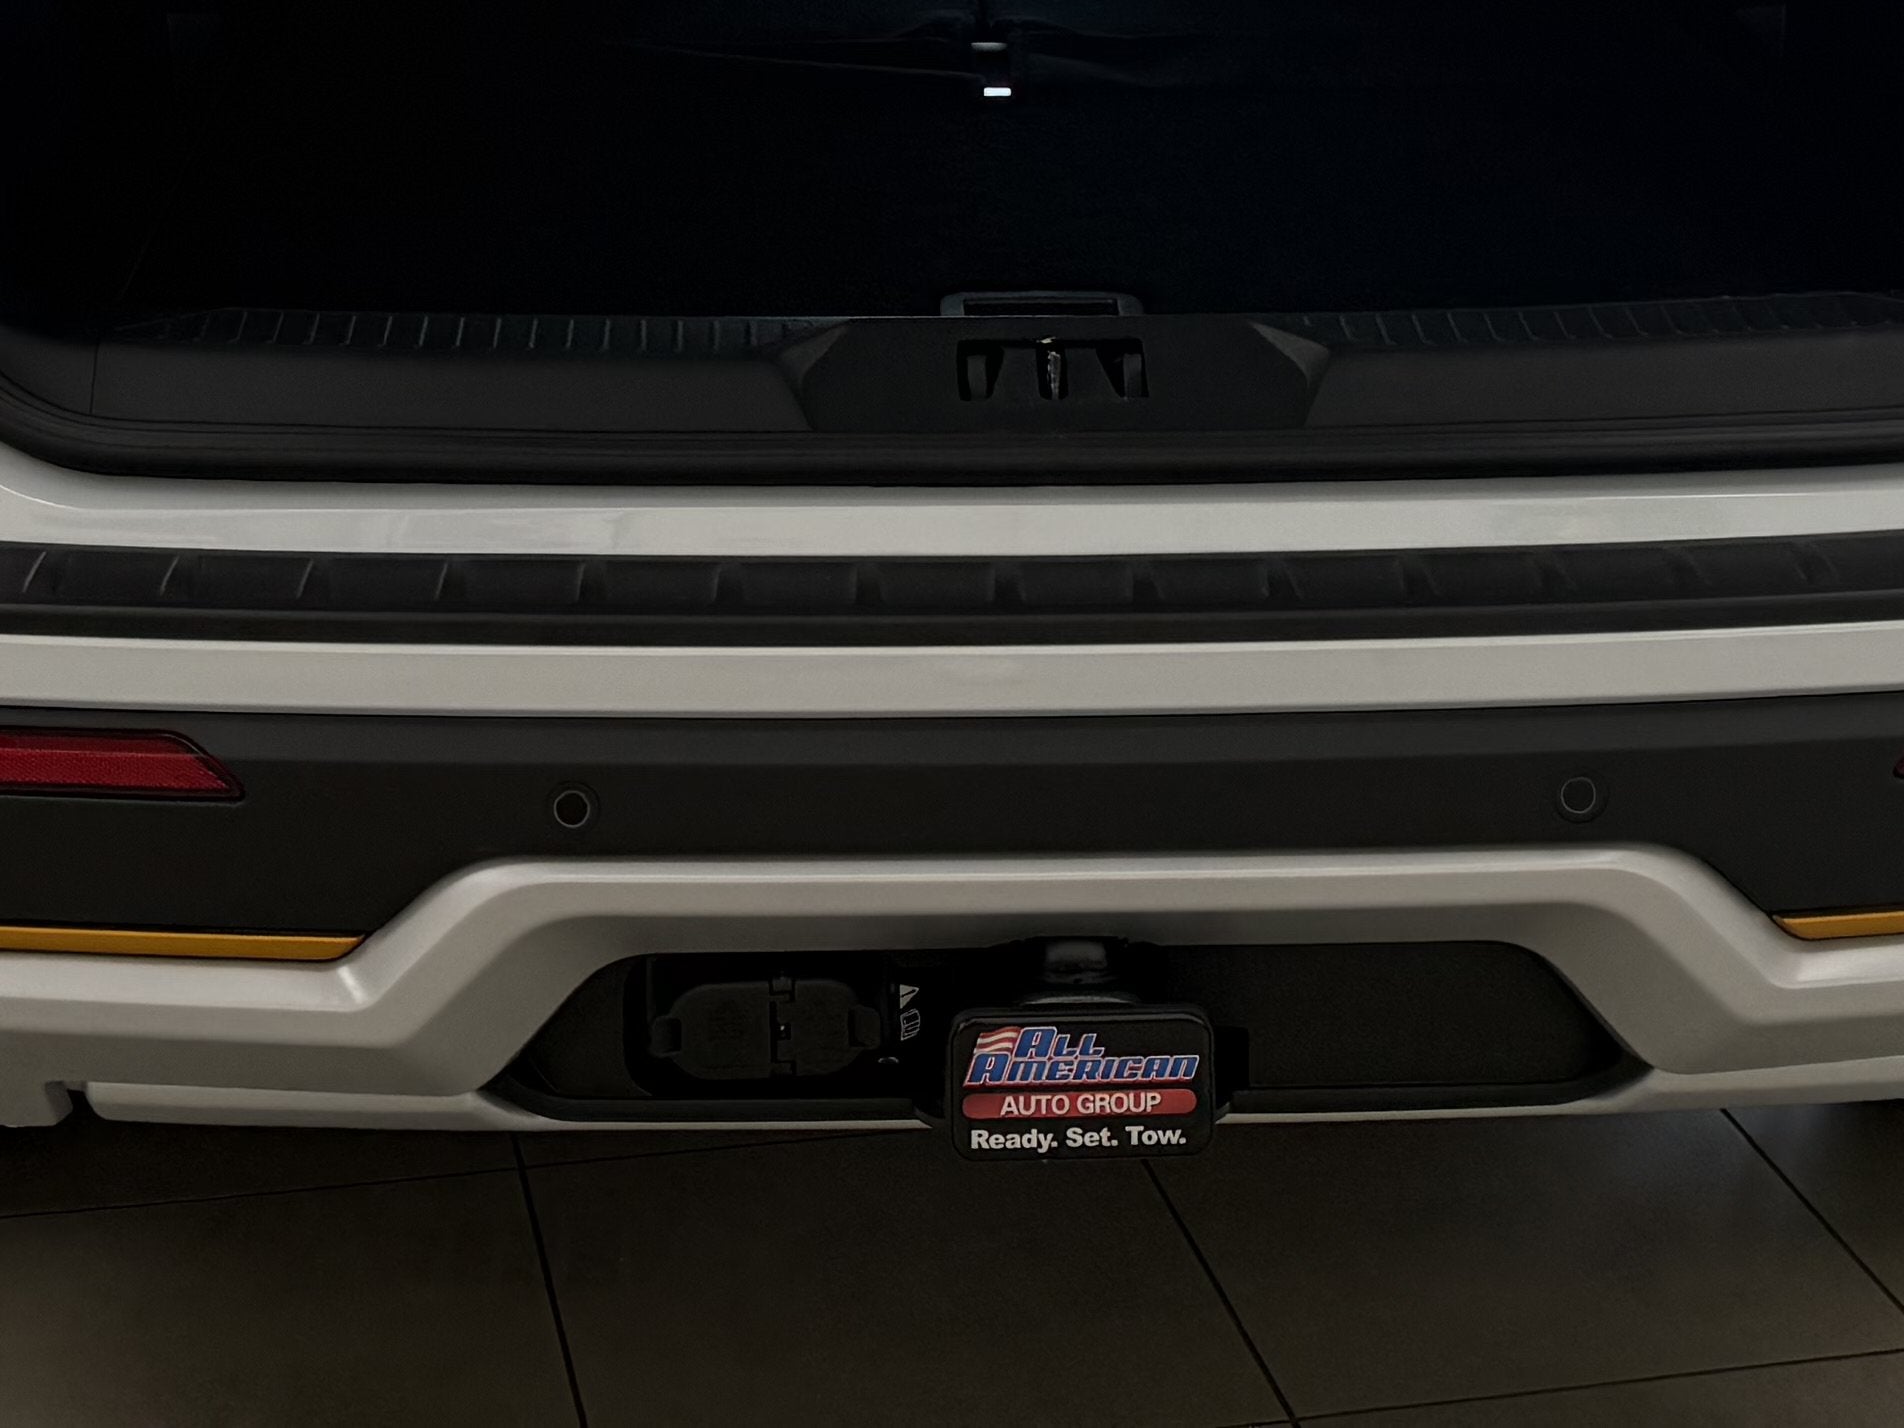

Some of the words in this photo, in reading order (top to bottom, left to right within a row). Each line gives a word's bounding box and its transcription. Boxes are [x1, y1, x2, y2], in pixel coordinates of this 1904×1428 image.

[1013, 1026, 1105, 1058] ALL
[963, 1052, 1200, 1087] AMERICAN
[999, 1094, 1070, 1117] AUTO
[1077, 1092, 1162, 1115] GROUP
[970, 1128, 1059, 1153] Ready.
[1065, 1126, 1119, 1148] Set.
[1124, 1125, 1187, 1146] Tow.
